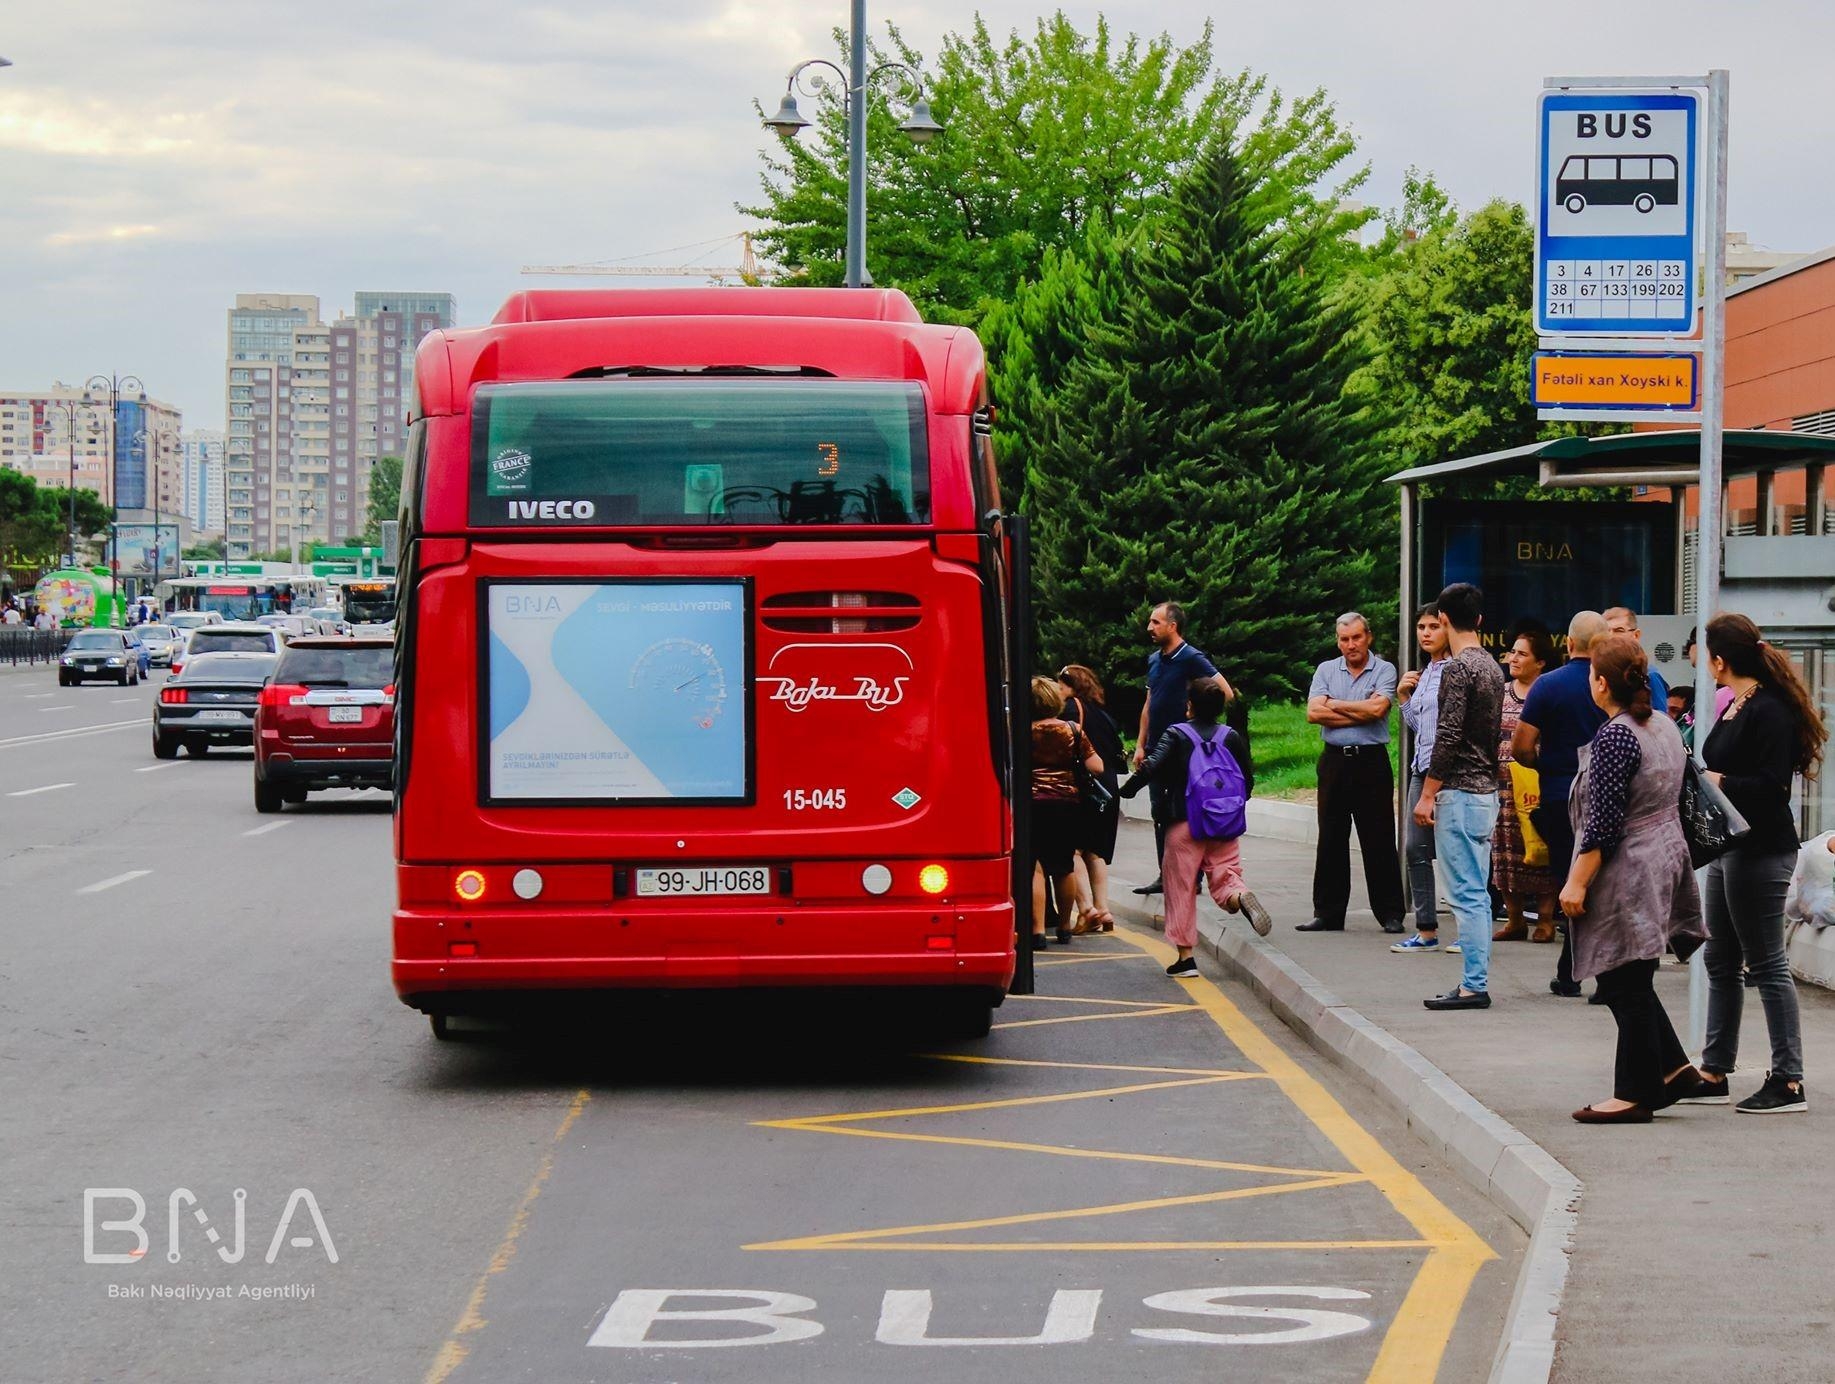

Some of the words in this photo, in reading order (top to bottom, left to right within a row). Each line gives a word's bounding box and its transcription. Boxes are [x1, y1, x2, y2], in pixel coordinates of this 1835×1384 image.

[1577, 113, 1652, 139] BUS
[1558, 265, 1566, 277] 3
[1584, 265, 1593, 277] 4
[1608, 265, 1625, 277] 17
[1636, 264, 1653, 277] 26
[1663, 264, 1681, 277] 33
[1551, 283, 1568, 296] 38
[1580, 284, 1598, 296] 67
[1603, 284, 1629, 296] 133
[1631, 284, 1657, 296] 199
[1658, 284, 1685, 296] 202
[1549, 302, 1574, 315] 211
[1542, 372, 1584, 385] Fətəli
[1588, 375, 1615, 386] xan
[1620, 374, 1671, 389] Xoyski
[1675, 375, 1689, 388] k.
[492, 456, 530, 472] FRANCE
[817, 442, 839, 476] 3
[508, 500, 595, 520] IVECO
[1517, 541, 1573, 560] BNA
[505, 595, 561, 613] BNA
[756, 677, 836, 706] Baku
[783, 789, 847, 810] 15-045
[1523, 792, 1541, 806] Sp
[658, 870, 765, 892] 99-JH-068
[585, 1286, 1373, 1349] BUS
